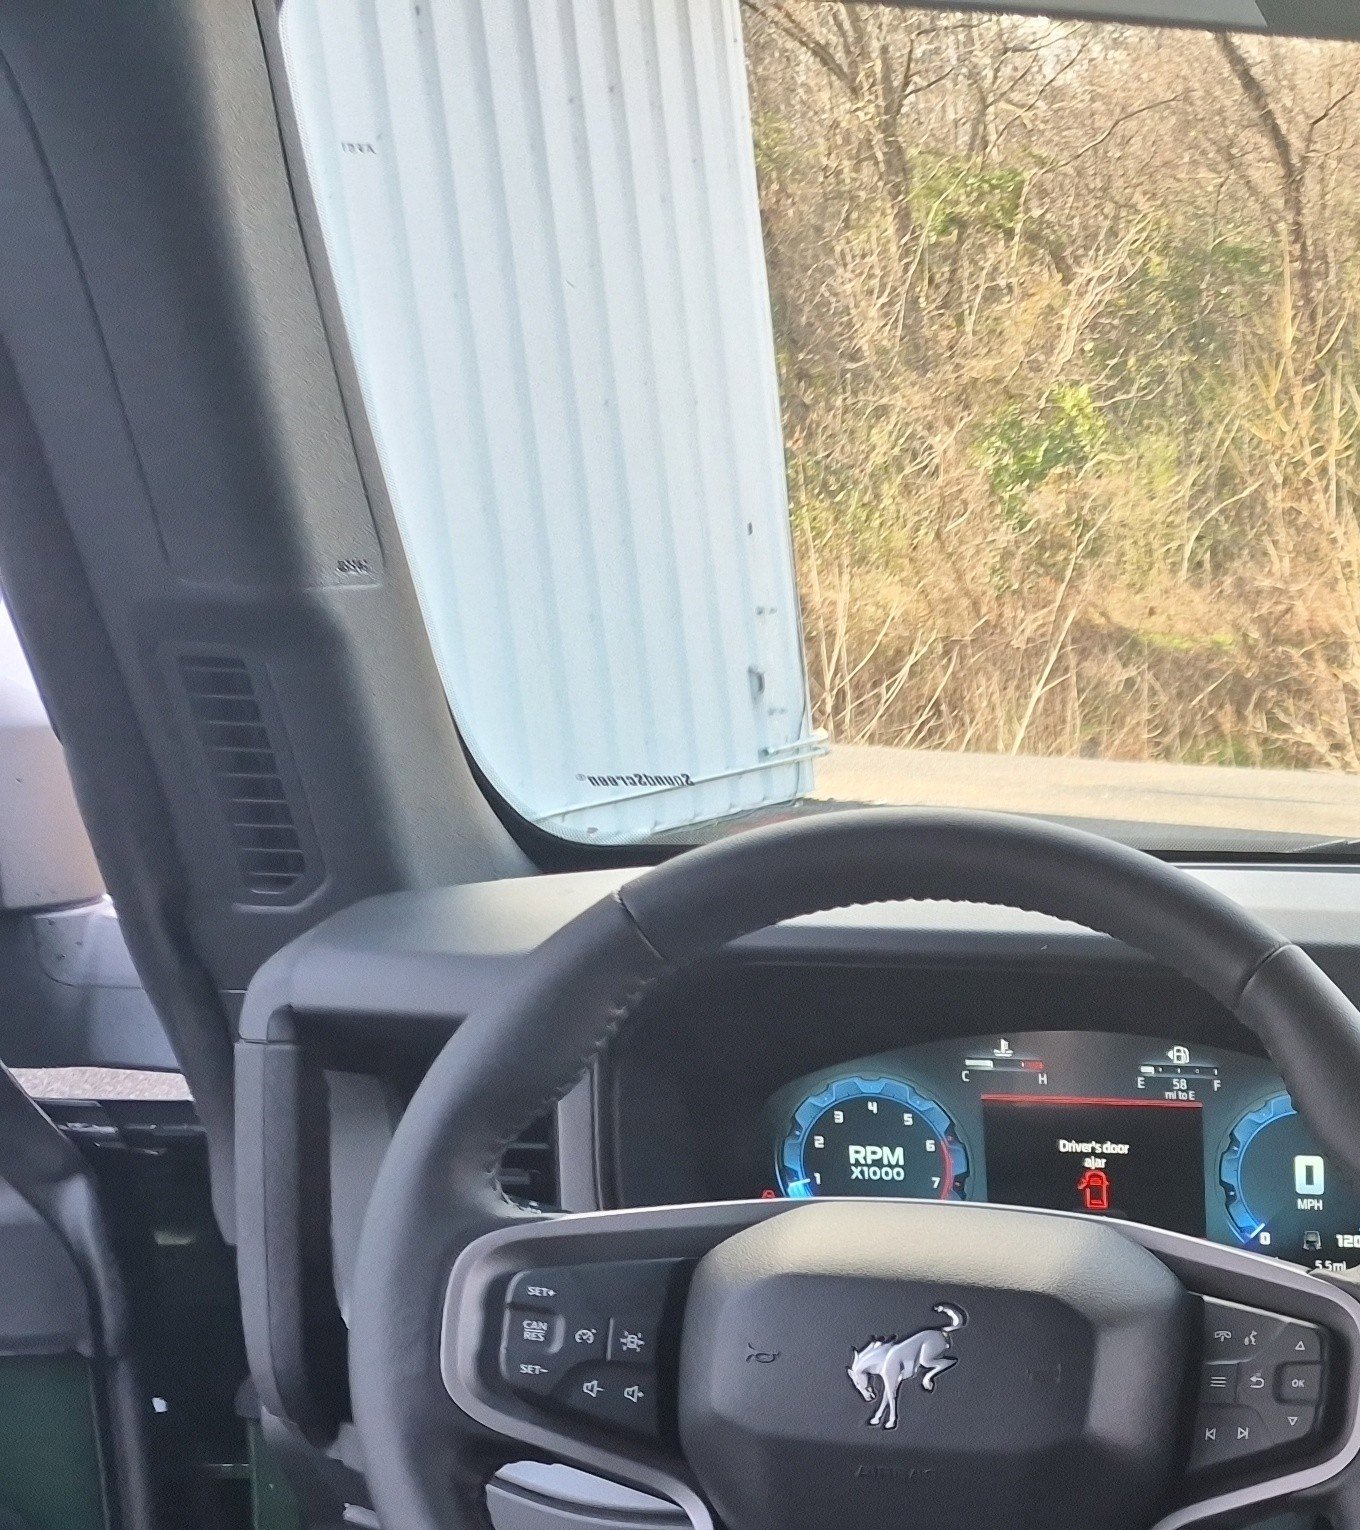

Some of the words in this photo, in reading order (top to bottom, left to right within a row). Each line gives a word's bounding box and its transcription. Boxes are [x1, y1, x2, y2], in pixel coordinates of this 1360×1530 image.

[962, 1070, 970, 1082] C
[1038, 1073, 1048, 1085] H
[1137, 1077, 1145, 1089] E
[1173, 1079, 1187, 1090] 58
[1213, 1080, 1221, 1091] F
[867, 1101, 878, 1114] 4
[833, 1110, 844, 1124] 3
[903, 1113, 913, 1126] 5
[814, 1136, 825, 1148] 2
[925, 1140, 936, 1151] 6
[1059, 1139, 1102, 1153] Driver's
[1103, 1141, 1129, 1154] door
[849, 1145, 904, 1165] RPM
[1084, 1156, 1106, 1169] ajar
[814, 1172, 821, 1185] 1
[850, 1166, 904, 1181] X1000
[1295, 1155, 1324, 1195] 0
[931, 1177, 941, 1189] 7
[1297, 1199, 1323, 1210] MPH
[1260, 1232, 1270, 1245] 0
[523, 1320, 548, 1330] CAN
[524, 1331, 545, 1341] RES
[1291, 1379, 1304, 1388] OK
